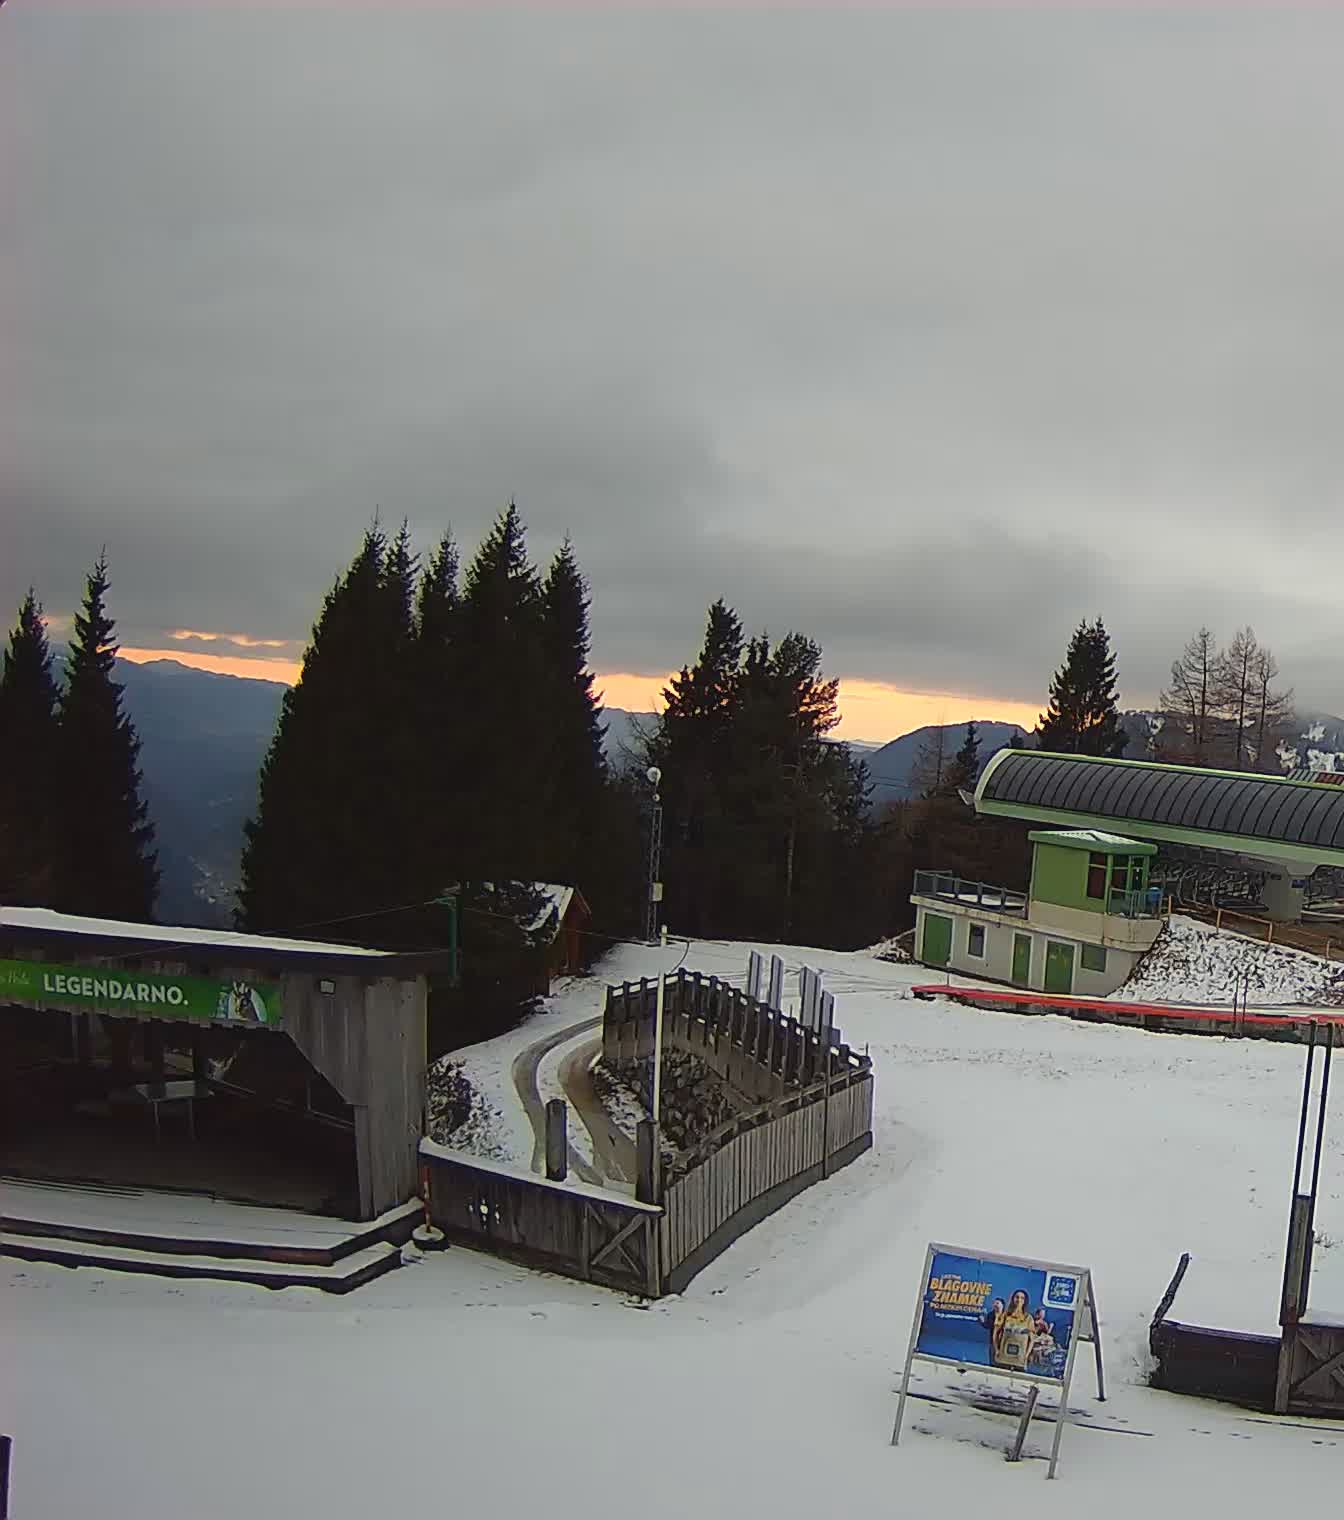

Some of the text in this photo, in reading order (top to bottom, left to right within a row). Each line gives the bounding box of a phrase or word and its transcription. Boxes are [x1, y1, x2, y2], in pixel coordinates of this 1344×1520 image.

[43, 973, 189, 1006] LEGENDARNO.
[930, 1278, 992, 1295] BLAGOVNE
[932, 1290, 985, 1306] ZNAMKE
